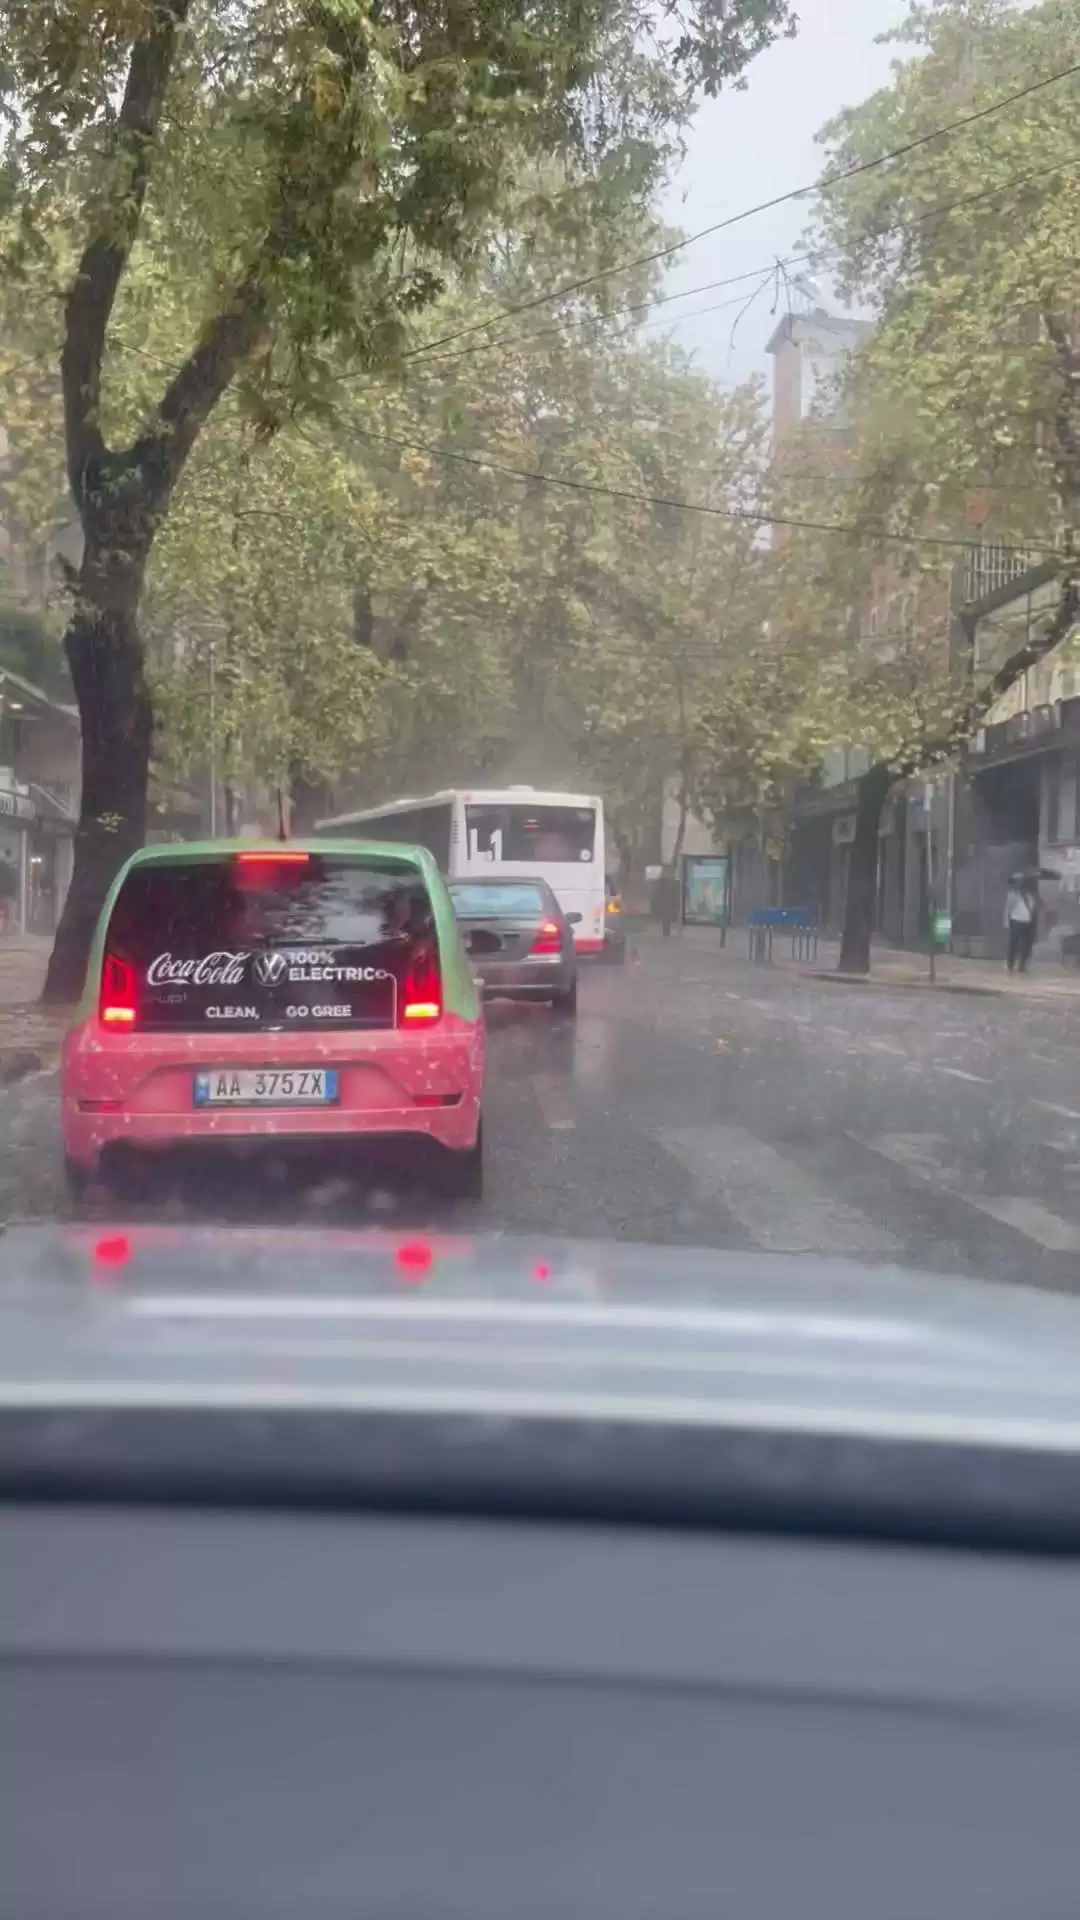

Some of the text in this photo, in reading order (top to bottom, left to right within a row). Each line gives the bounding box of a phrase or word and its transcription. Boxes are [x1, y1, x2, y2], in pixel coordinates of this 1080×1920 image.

[289, 951, 336, 965] 100%
[205, 1004, 353, 1020] CLEAN, GO GREE
[216, 1073, 241, 1096] AA
